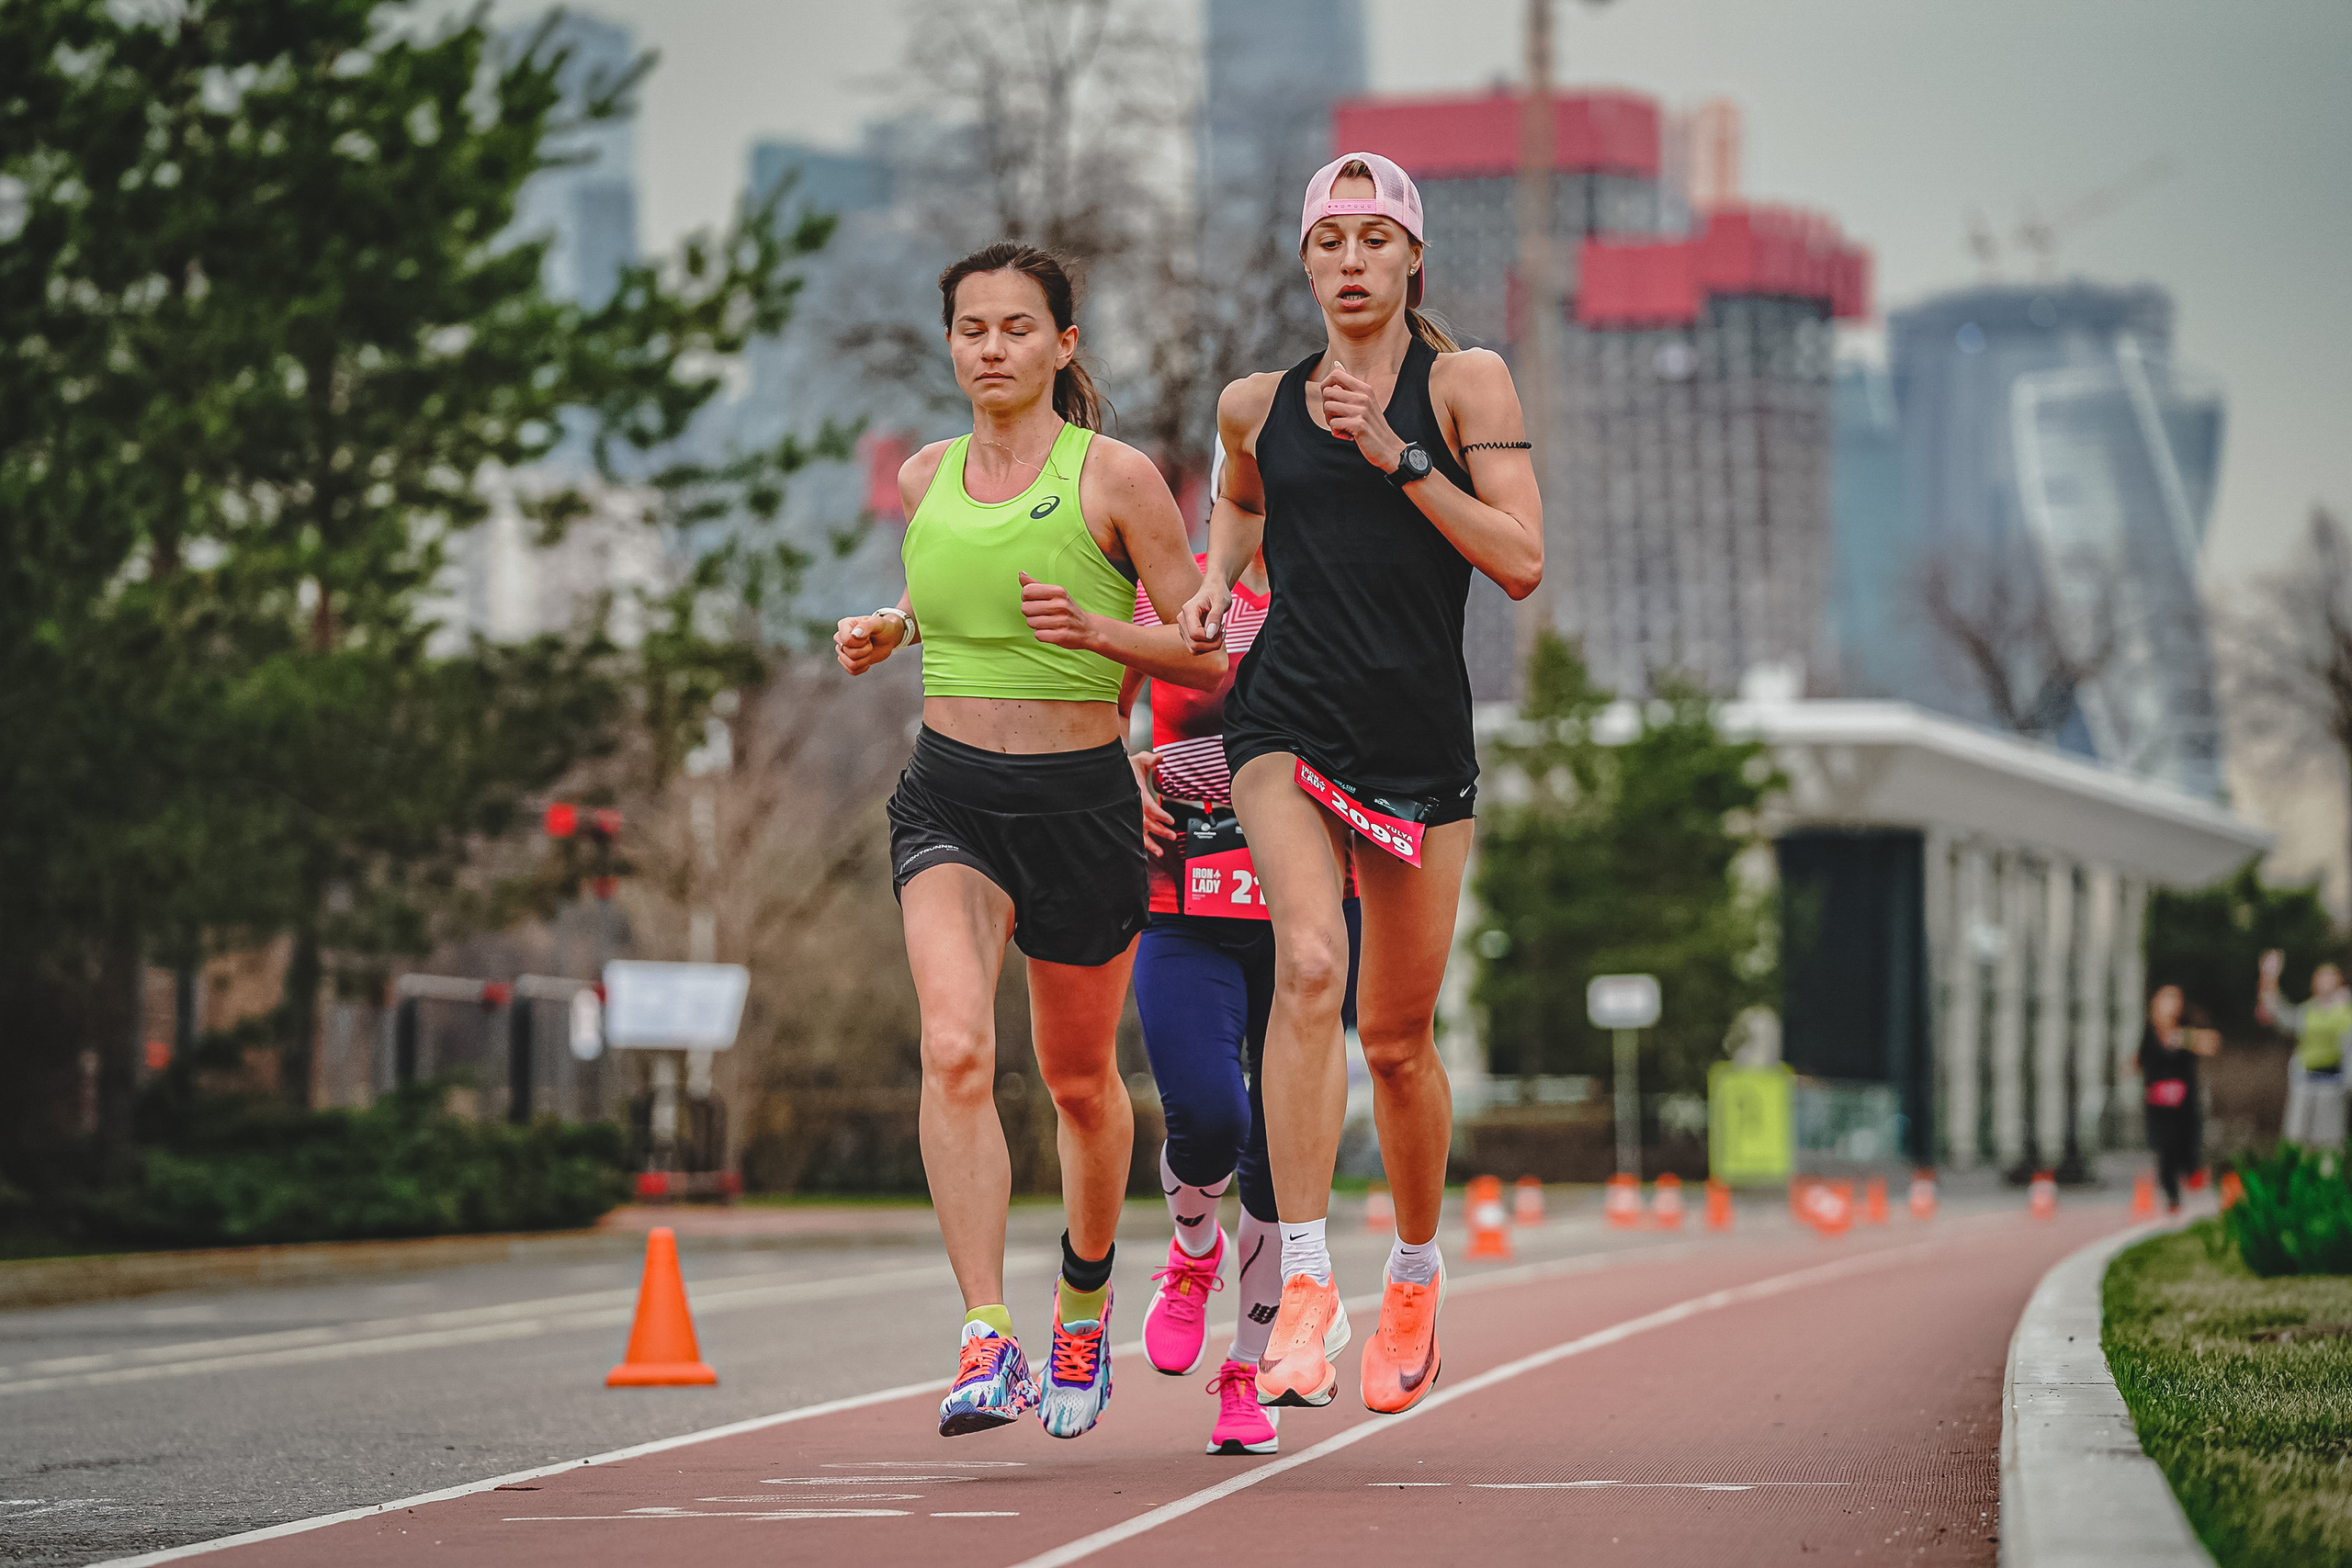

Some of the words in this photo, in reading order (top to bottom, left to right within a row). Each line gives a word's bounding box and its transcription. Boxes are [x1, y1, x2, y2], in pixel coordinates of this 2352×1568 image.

[1300, 770, 1326, 793] LADY
[1301, 764, 1319, 782] IRON
[1331, 790, 1414, 856] 2099
[1385, 823, 1413, 843] YULYA
[1192, 867, 1214, 879] IRON
[1192, 878, 1221, 894] LADY
